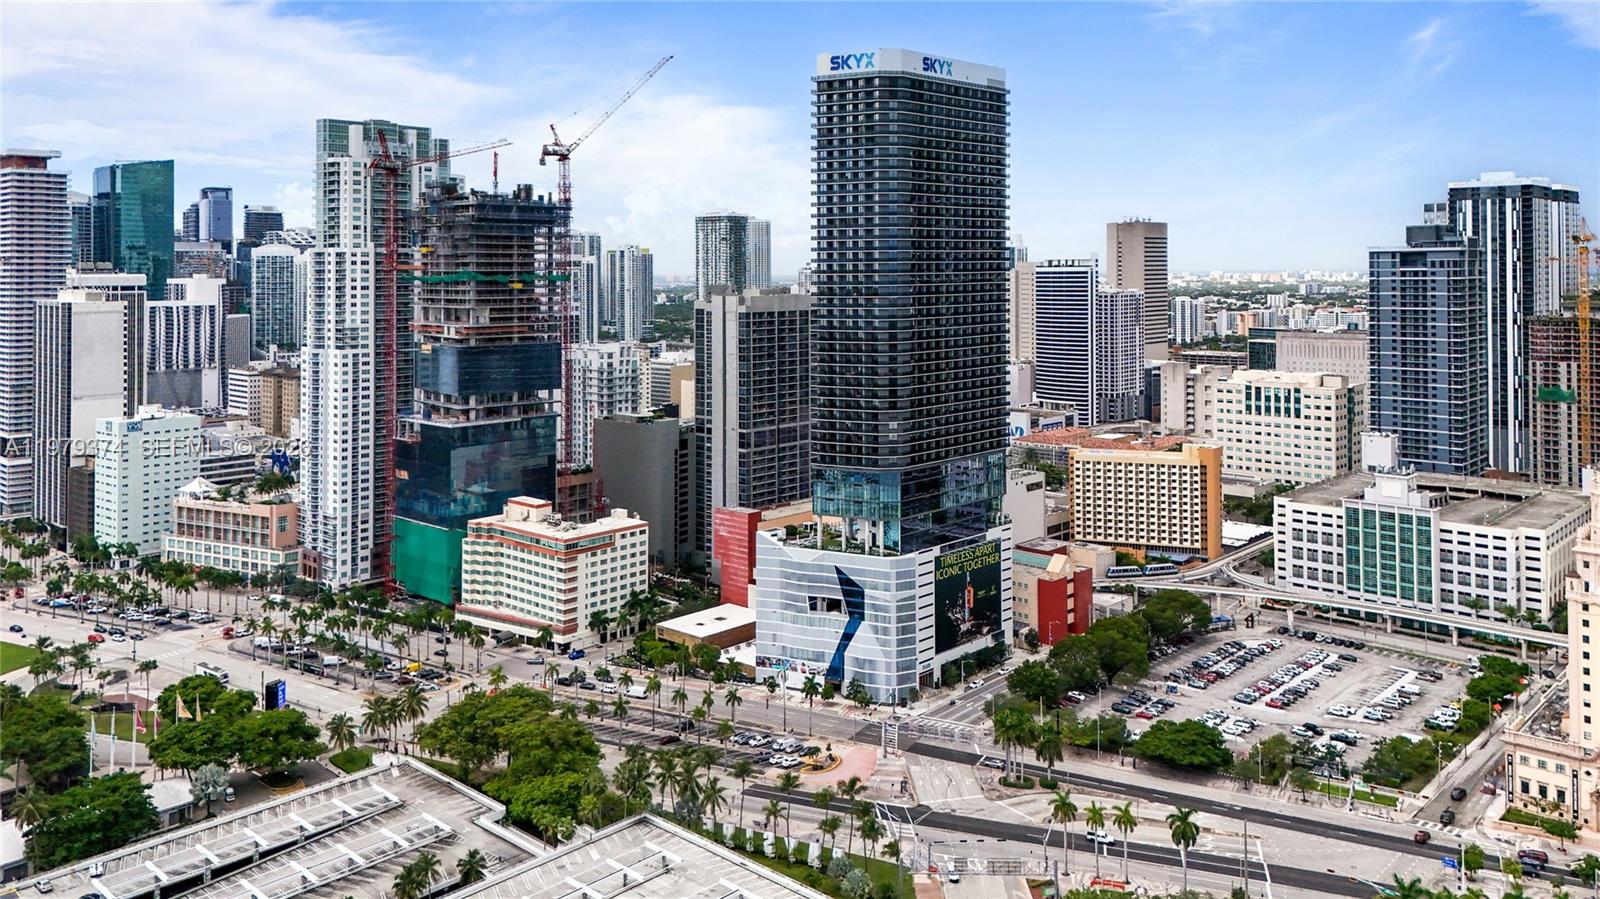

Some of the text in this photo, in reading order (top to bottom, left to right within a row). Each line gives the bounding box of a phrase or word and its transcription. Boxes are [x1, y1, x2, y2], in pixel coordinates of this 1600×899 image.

[830, 52, 875, 71] SKYX
[922, 56, 953, 76] SKYX
[941, 543, 996, 567] TIMELESS APART
[936, 553, 1000, 580] ICONIC TOGETHER
